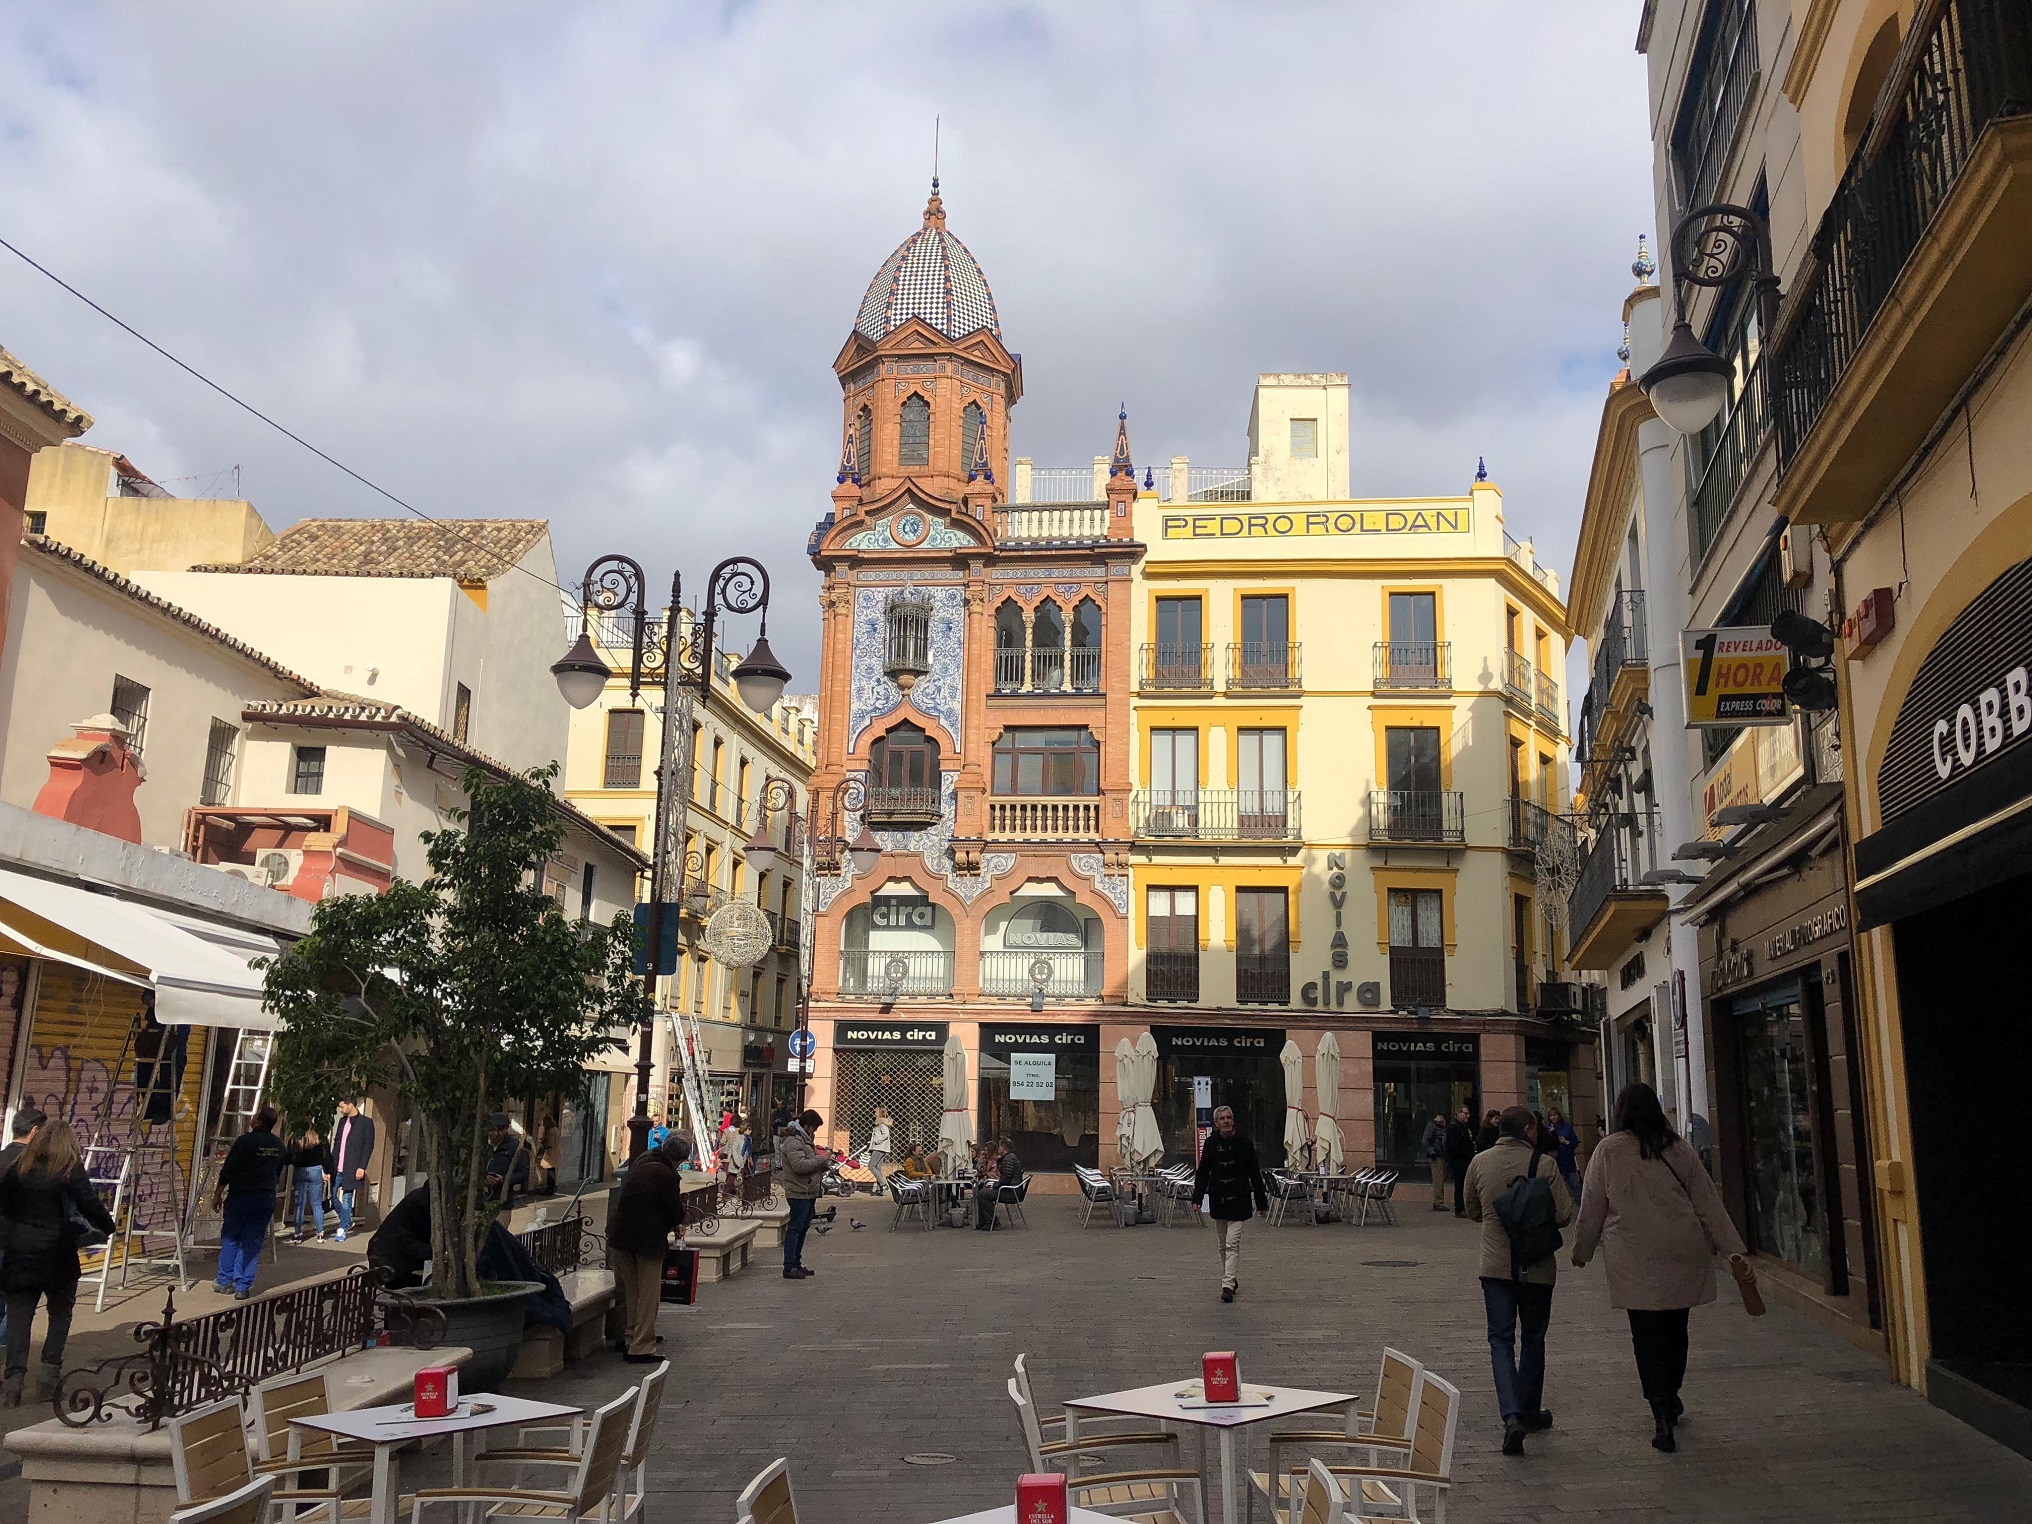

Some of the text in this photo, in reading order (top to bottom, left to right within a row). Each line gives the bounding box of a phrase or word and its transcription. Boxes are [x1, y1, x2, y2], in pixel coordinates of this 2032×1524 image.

[1164, 510, 1459, 538] PEDRO ROLDAN
[1717, 639, 1783, 653] REVELADO
[1695, 633, 1717, 696] 1
[1715, 661, 1783, 688] HORA
[1720, 699, 1782, 712] EXPRESS COLOR
[1933, 666, 2032, 779] COBB
[873, 898, 932, 926] cira
[1327, 852, 1349, 969] NOVIAS
[1009, 933, 1079, 946] NOVIAS
[1301, 970, 1381, 1007] cira
[847, 1029, 936, 1040] NOVIAS cira
[995, 1033, 1085, 1044] NOVIAS cira
[1171, 1036, 1265, 1047] NOVIAS cira
[1377, 1041, 1473, 1052] NOVIAS cira
